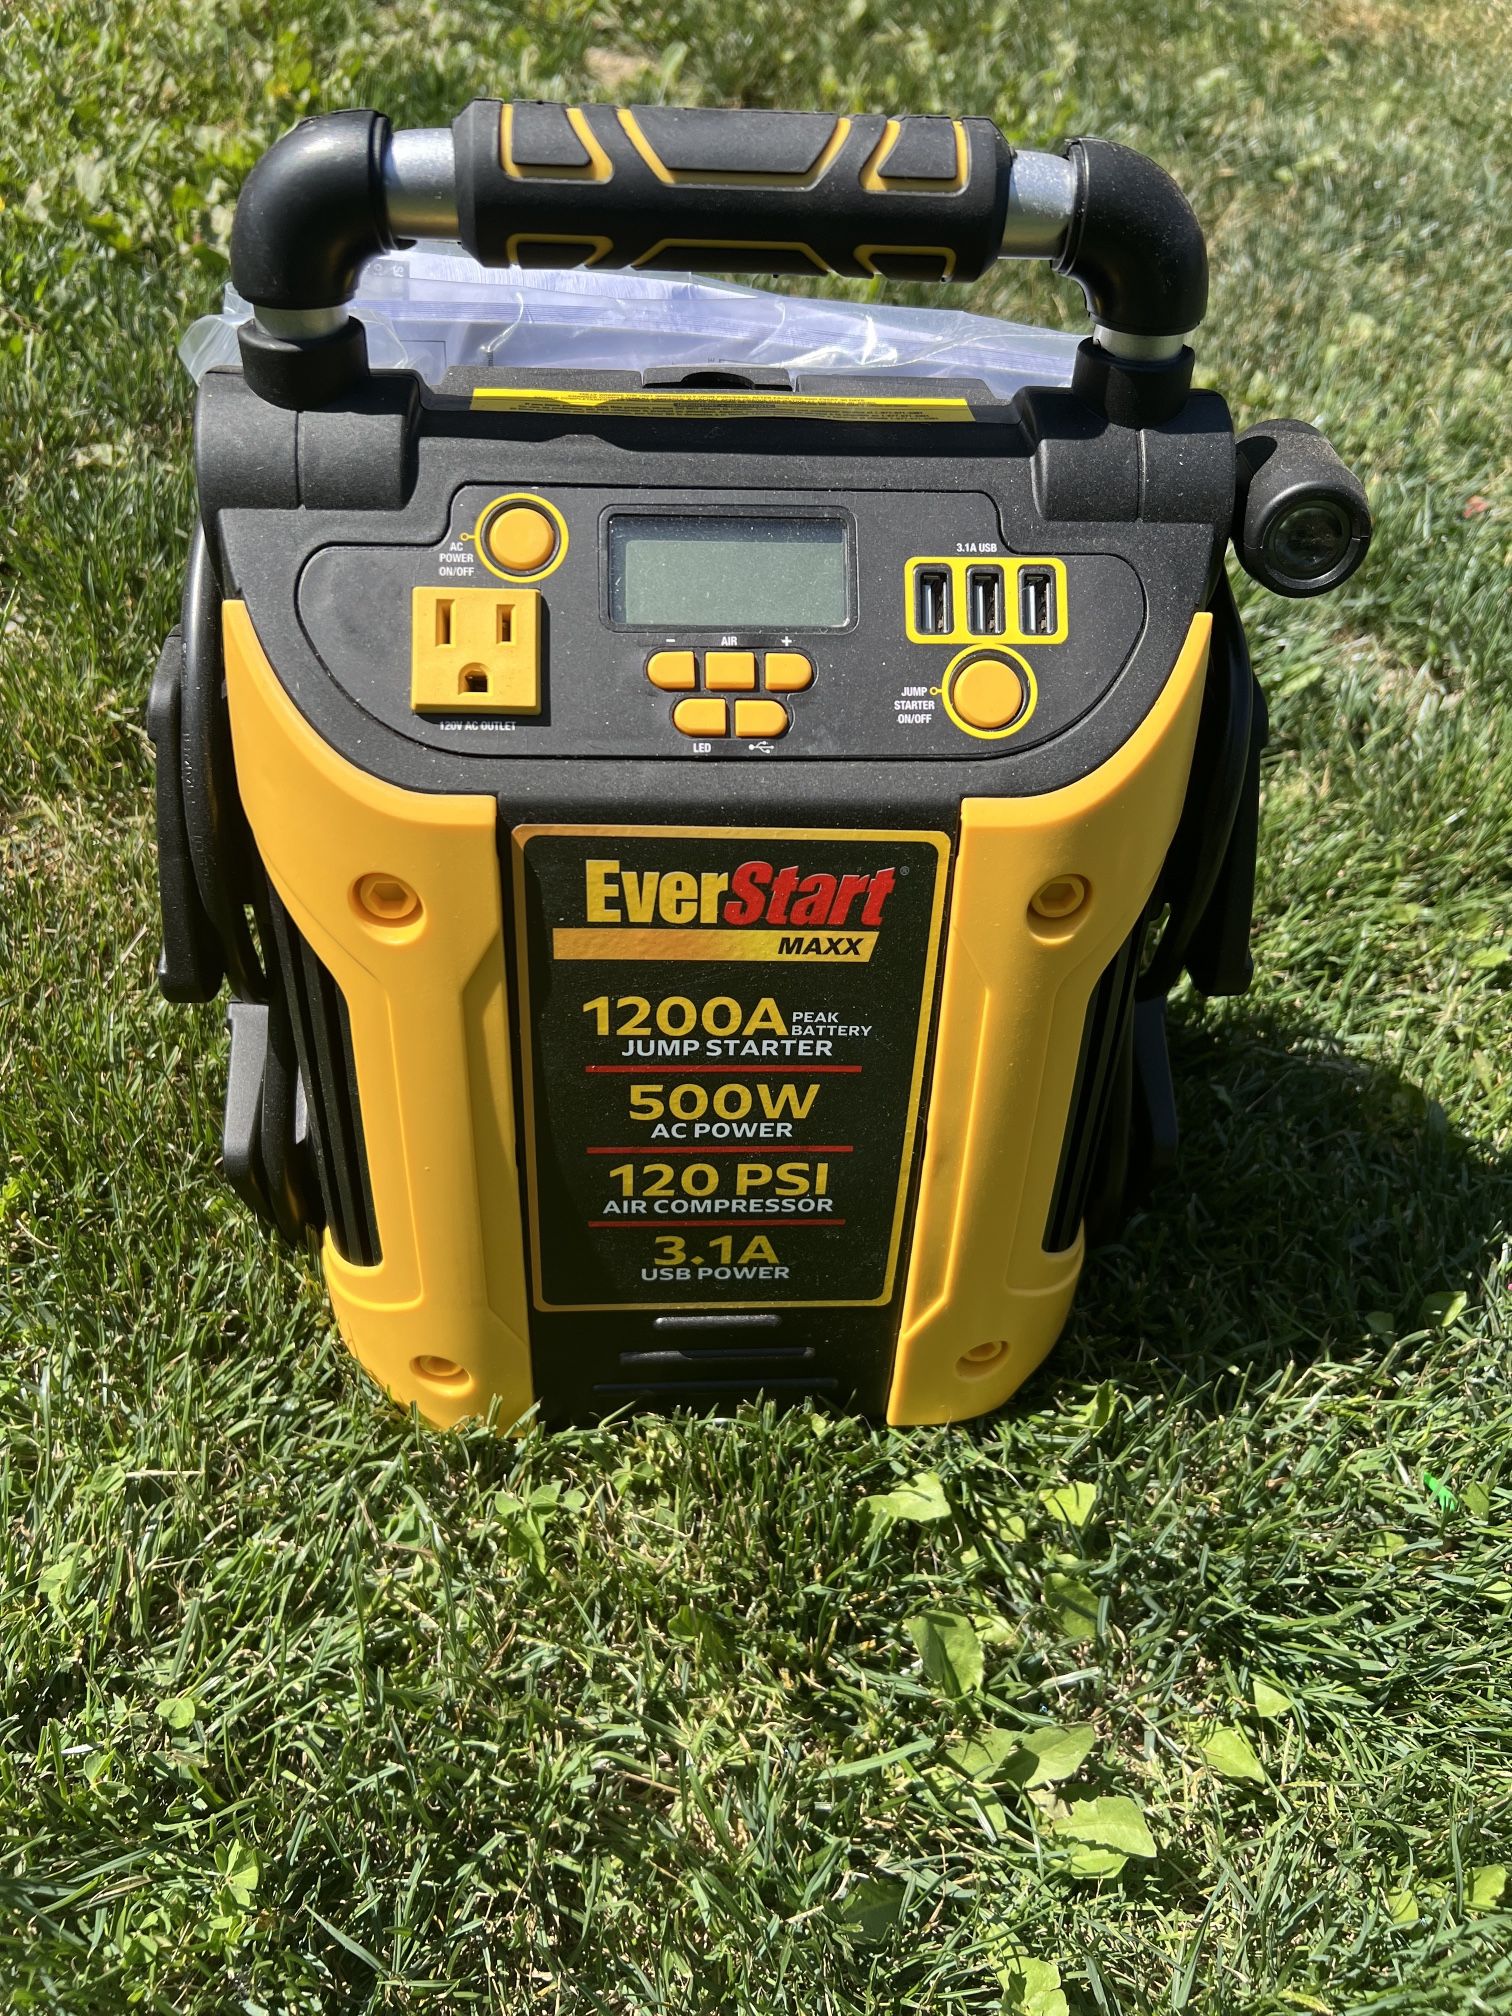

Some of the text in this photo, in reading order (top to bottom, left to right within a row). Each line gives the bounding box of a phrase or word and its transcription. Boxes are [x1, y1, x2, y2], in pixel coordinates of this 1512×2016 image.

[450, 542, 464, 551] AC
[956, 543, 997, 552] 3.1A USB
[439, 553, 474, 563] POWER
[438, 567, 475, 577] ON/OFF
[721, 636, 737, 646] AIR
[901, 686, 927, 696] JUMP
[894, 700, 935, 710] STARTER
[897, 714, 932, 724] ON/OFF
[440, 721, 517, 731] 120V AC OUTLET
[693, 743, 712, 753] LED
[585, 859, 896, 926] EverStart
[778, 937, 864, 956] MAXX
[582, 996, 790, 1036] 1200A
[792, 1012, 839, 1023] PEAK
[791, 1025, 872, 1037] BATTERY
[621, 1040, 833, 1056] JUMP STARTER
[629, 1083, 820, 1120] 500W
[651, 1122, 793, 1139] AC POWER
[608, 1162, 829, 1197] 120 PSI
[602, 1198, 833, 1214] AIR COMPRESSOR
[654, 1235, 780, 1265] 3.1A
[641, 1266, 790, 1281] USB POWER
